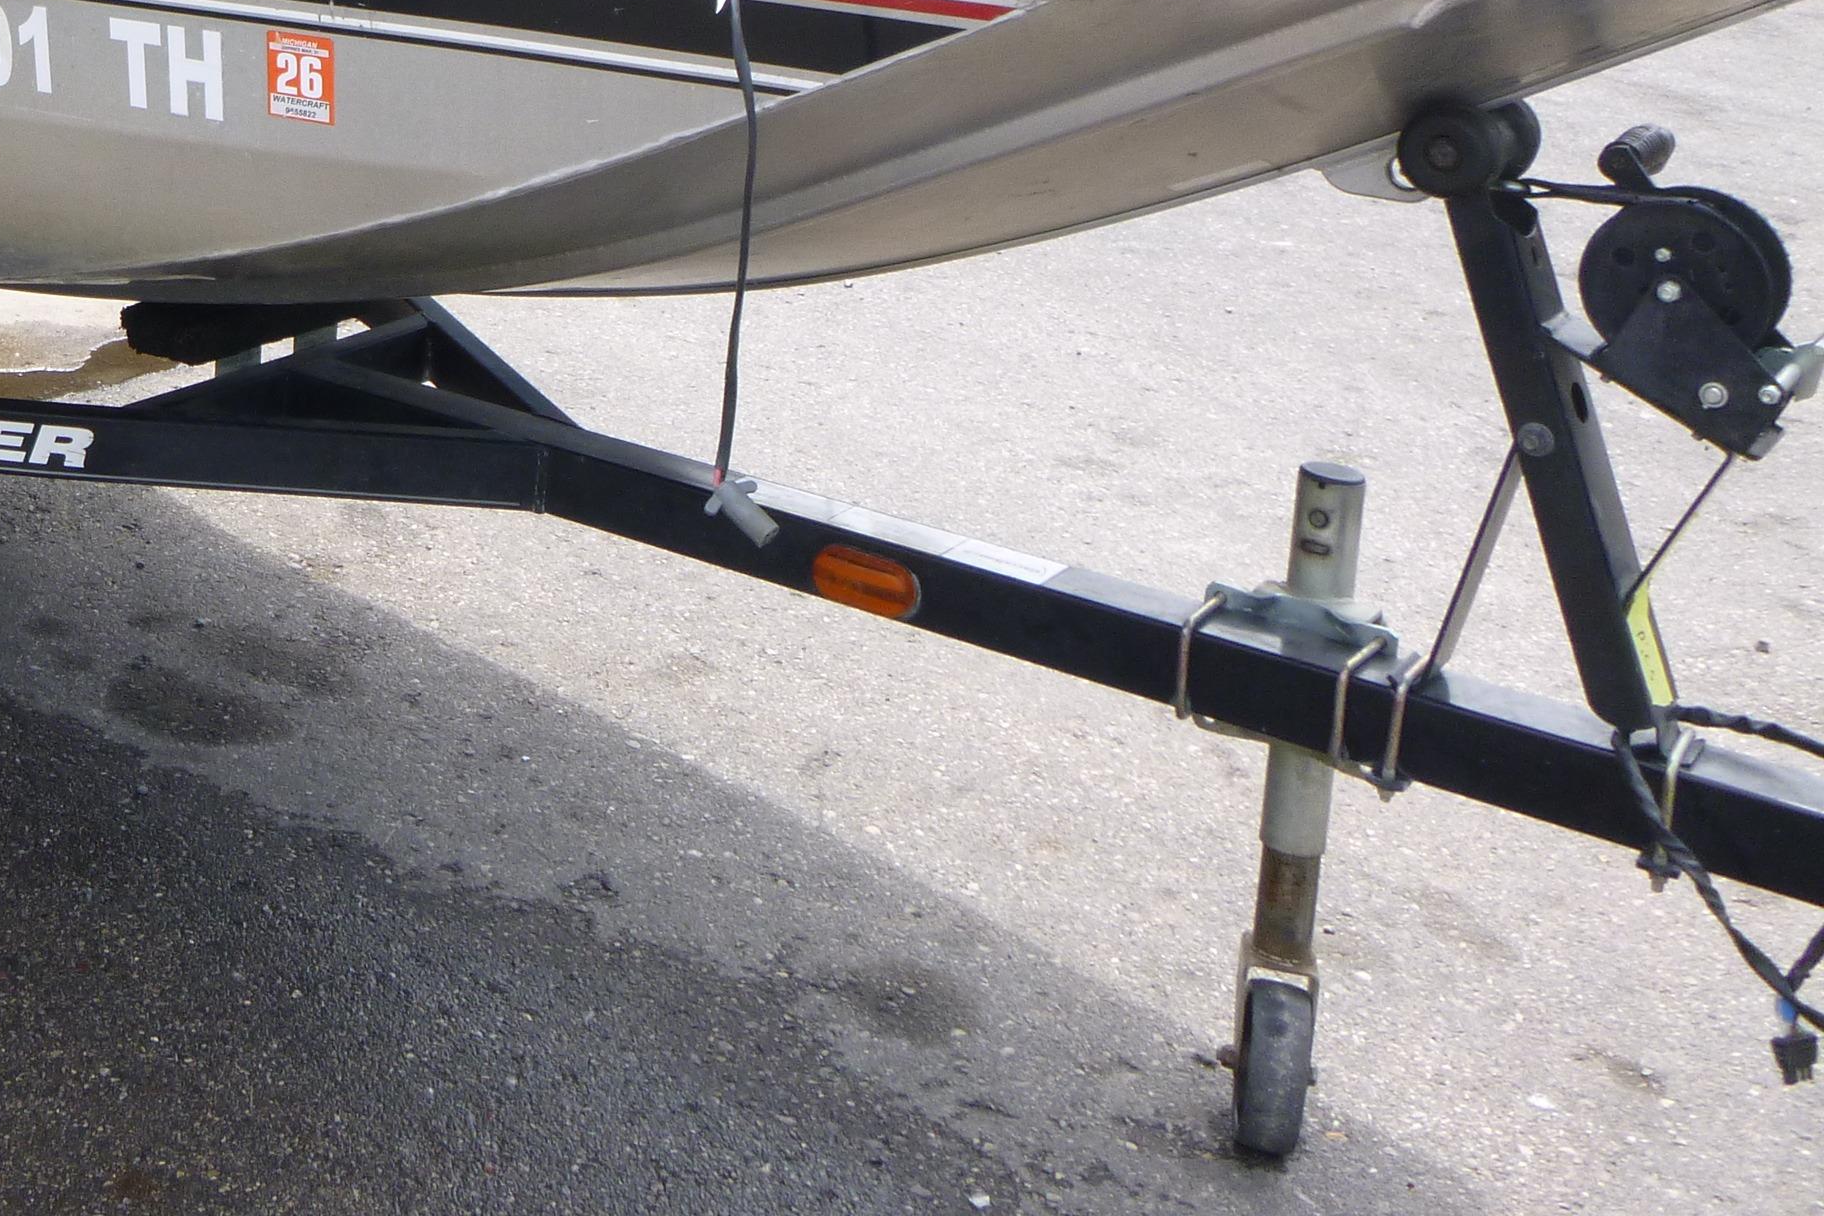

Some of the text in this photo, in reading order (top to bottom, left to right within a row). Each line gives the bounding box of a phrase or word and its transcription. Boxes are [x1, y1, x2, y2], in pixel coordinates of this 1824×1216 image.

[281, 37, 319, 49] MICHIGAN
[109, 16, 224, 122] TH
[276, 53, 323, 99] 26
[273, 94, 330, 111] WATERCRAFT
